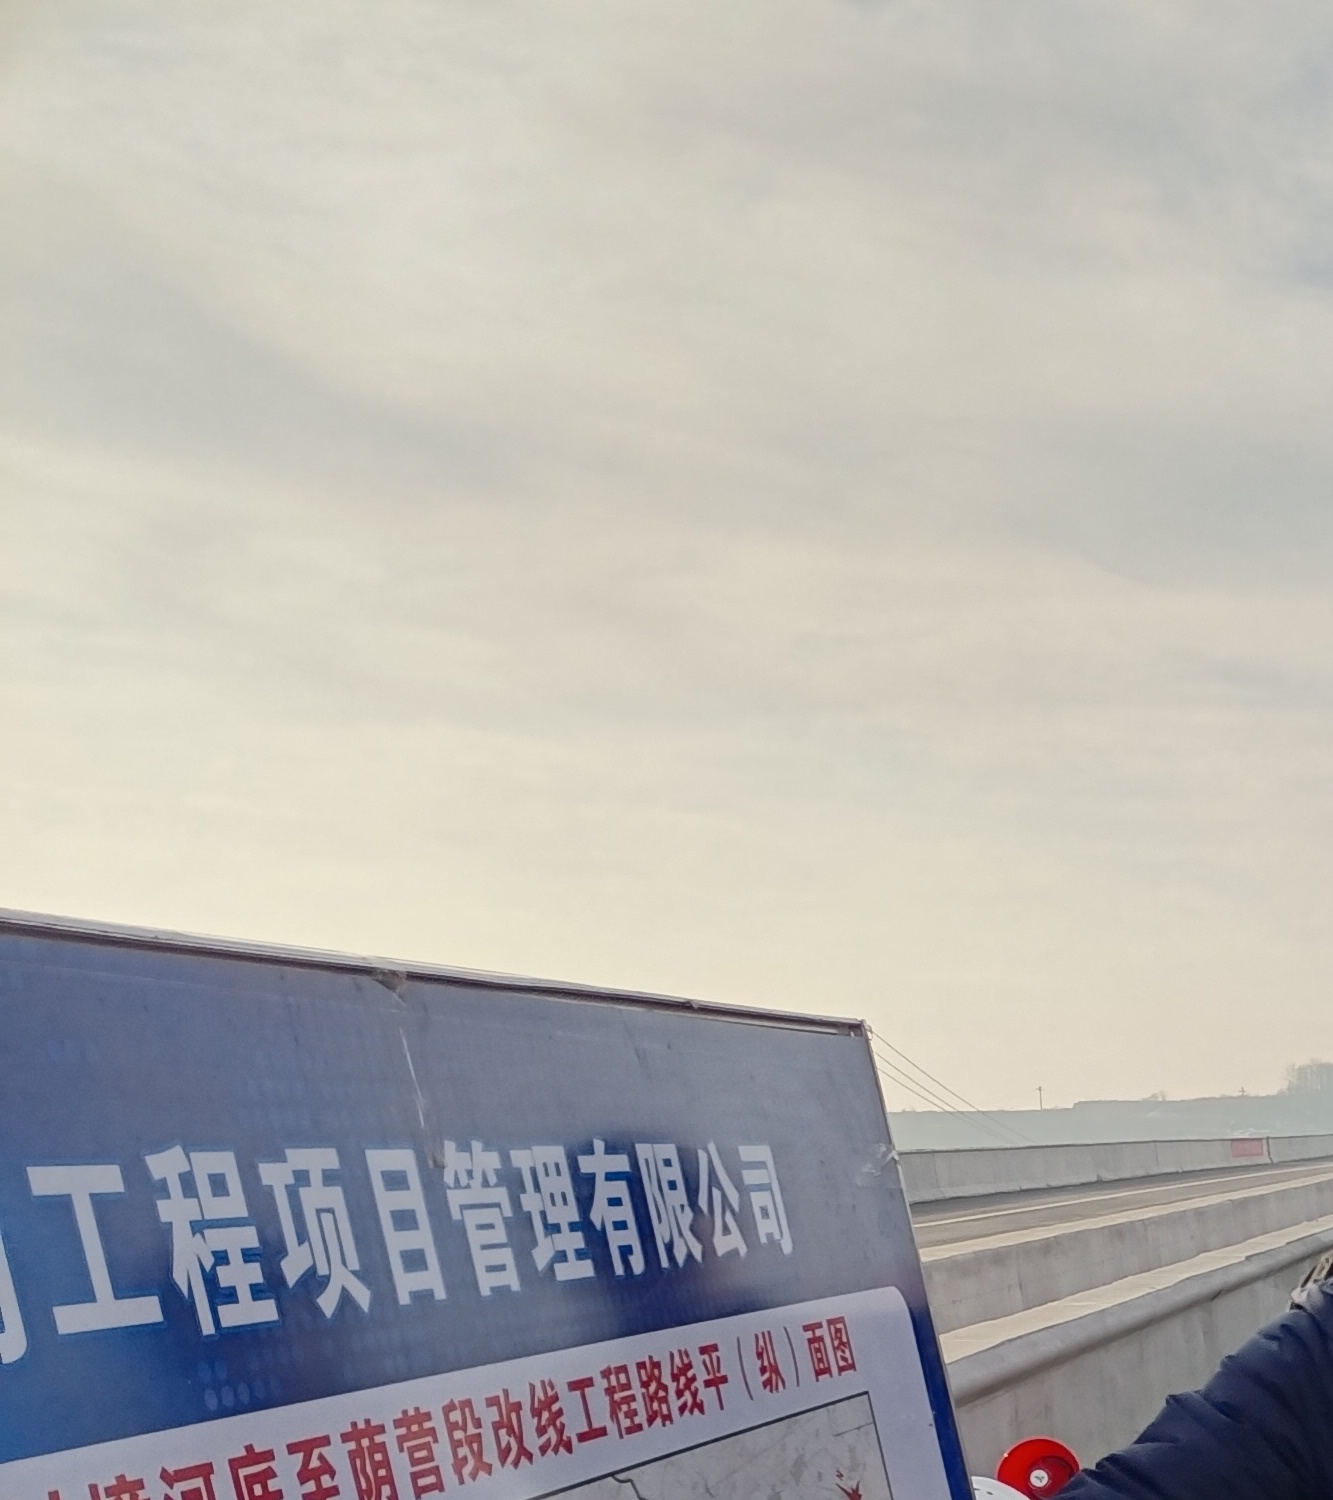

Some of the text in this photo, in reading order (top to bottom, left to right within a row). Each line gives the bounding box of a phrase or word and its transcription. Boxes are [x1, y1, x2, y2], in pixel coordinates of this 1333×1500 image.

[0, 1137, 794, 1364] 工程项目管理有限公司
